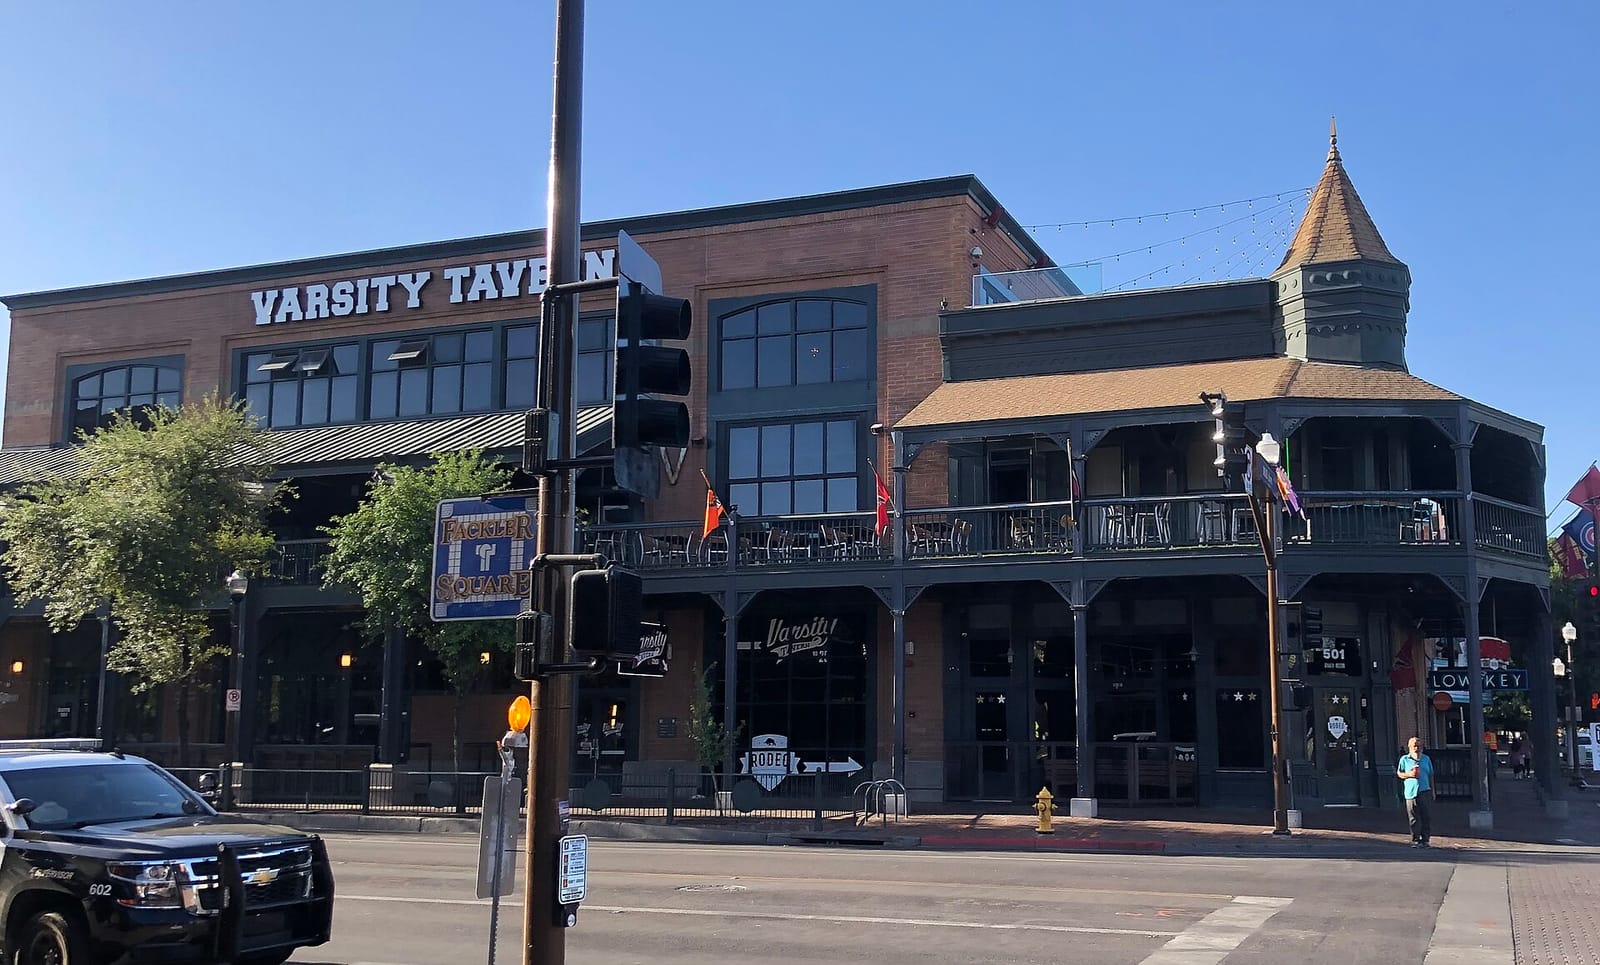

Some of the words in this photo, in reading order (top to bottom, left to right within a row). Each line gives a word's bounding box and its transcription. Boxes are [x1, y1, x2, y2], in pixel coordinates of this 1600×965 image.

[251, 271, 431, 325] VARSITY
[444, 249, 616, 304] TAVEN
[441, 514, 533, 545] FACKLER
[436, 570, 531, 601] SQUARE
[1323, 649, 1345, 659] 501
[1433, 674, 1470, 688] LOW
[1485, 674, 1521, 688] KEY
[89, 884, 112, 896] 602
